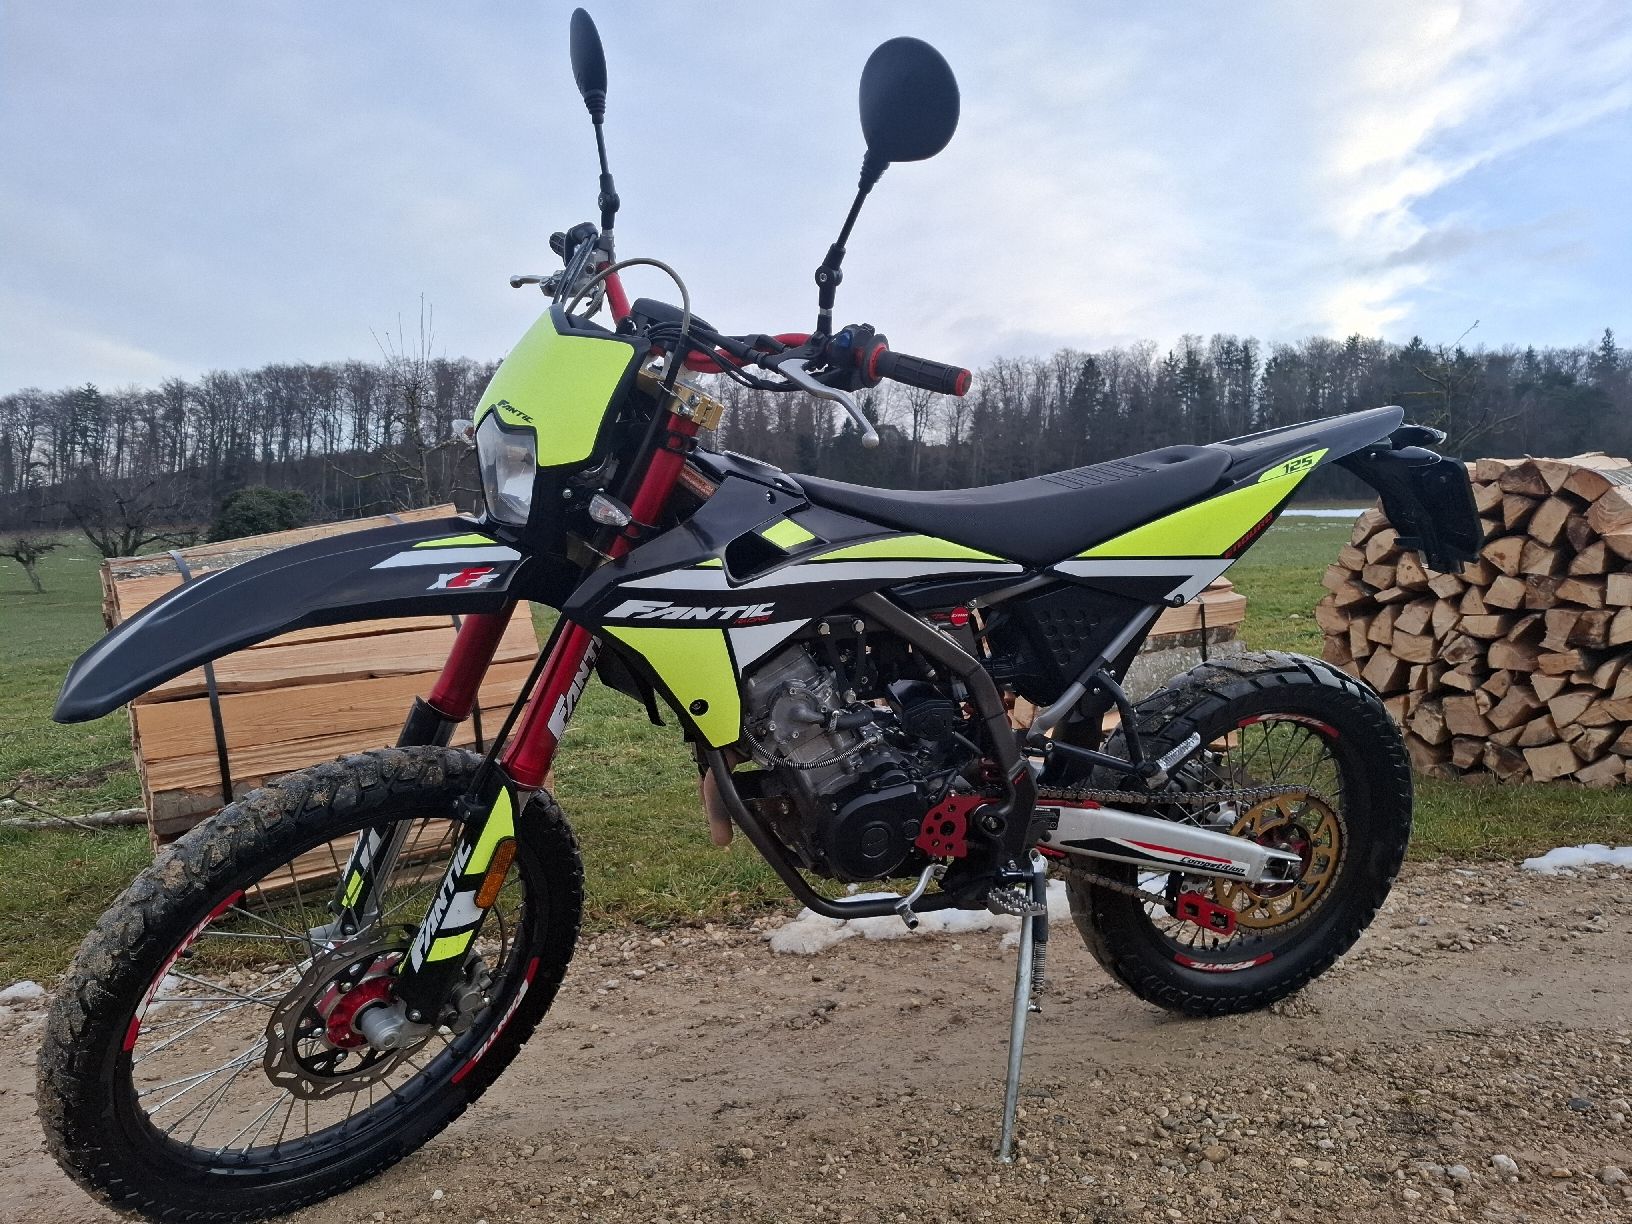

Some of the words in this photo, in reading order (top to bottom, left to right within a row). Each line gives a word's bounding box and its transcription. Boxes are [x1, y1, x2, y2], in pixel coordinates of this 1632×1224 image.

[497, 400, 533, 424] FANTIC
[1282, 455, 1313, 475] 125
[603, 599, 776, 620] FANTIC
[1181, 856, 1247, 873] Competition
[411, 838, 472, 974] FANTIC
